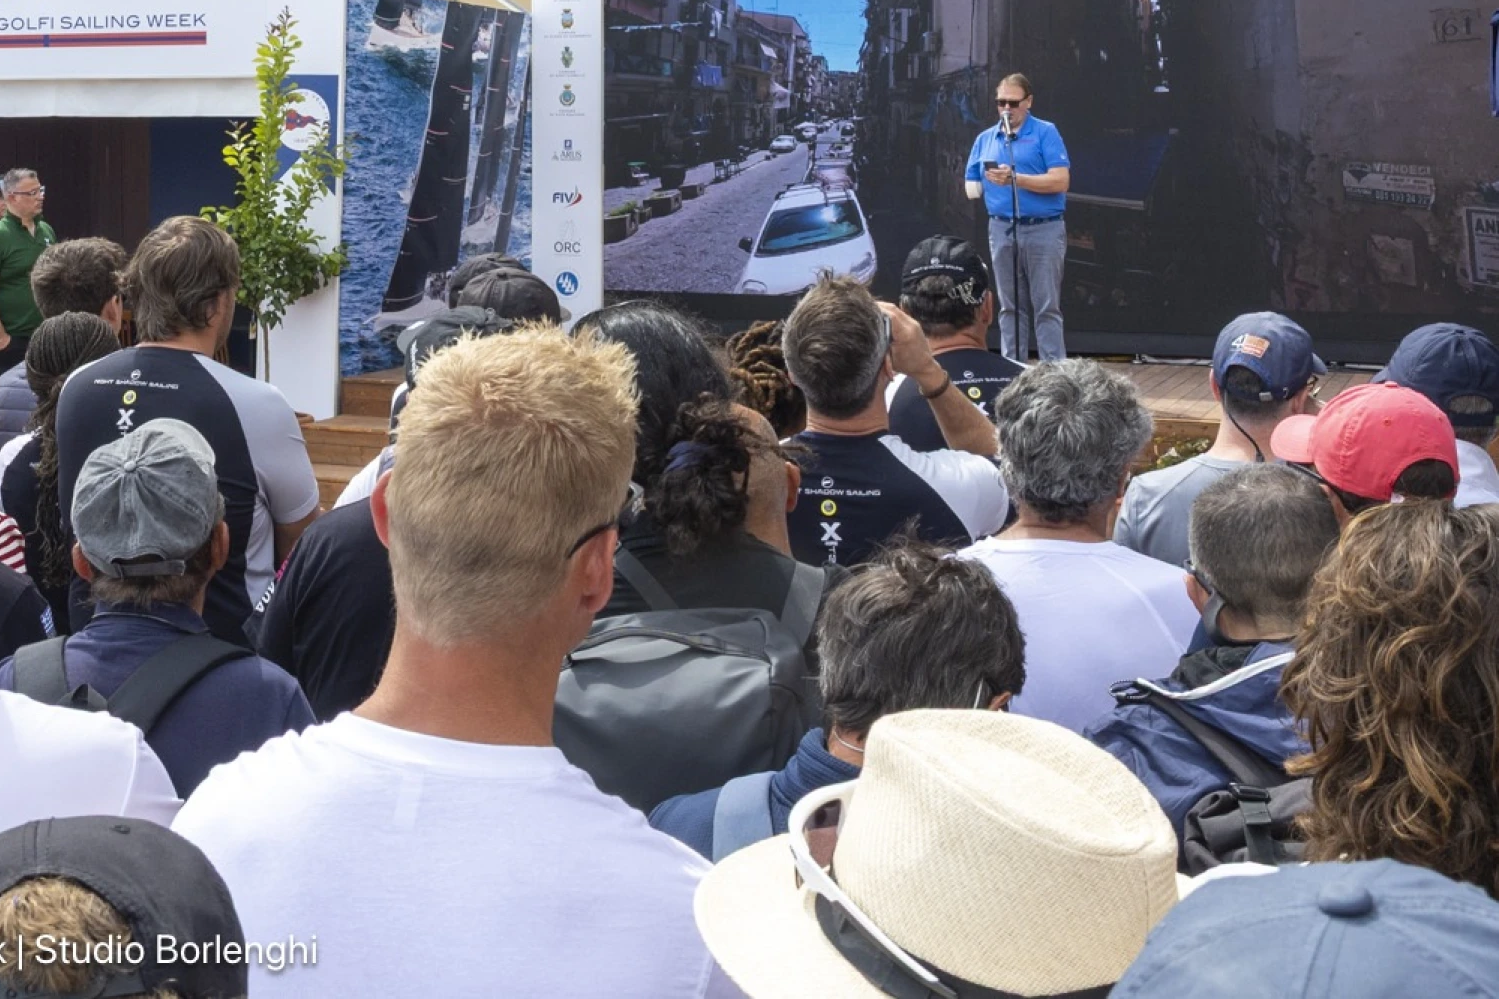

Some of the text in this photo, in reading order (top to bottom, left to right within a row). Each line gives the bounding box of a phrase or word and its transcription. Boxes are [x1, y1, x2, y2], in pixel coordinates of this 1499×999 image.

[60, 14, 141, 31] SAILING
[146, 12, 207, 29] WEEK
[552, 192, 575, 203] FIV
[553, 241, 581, 253] ORC
